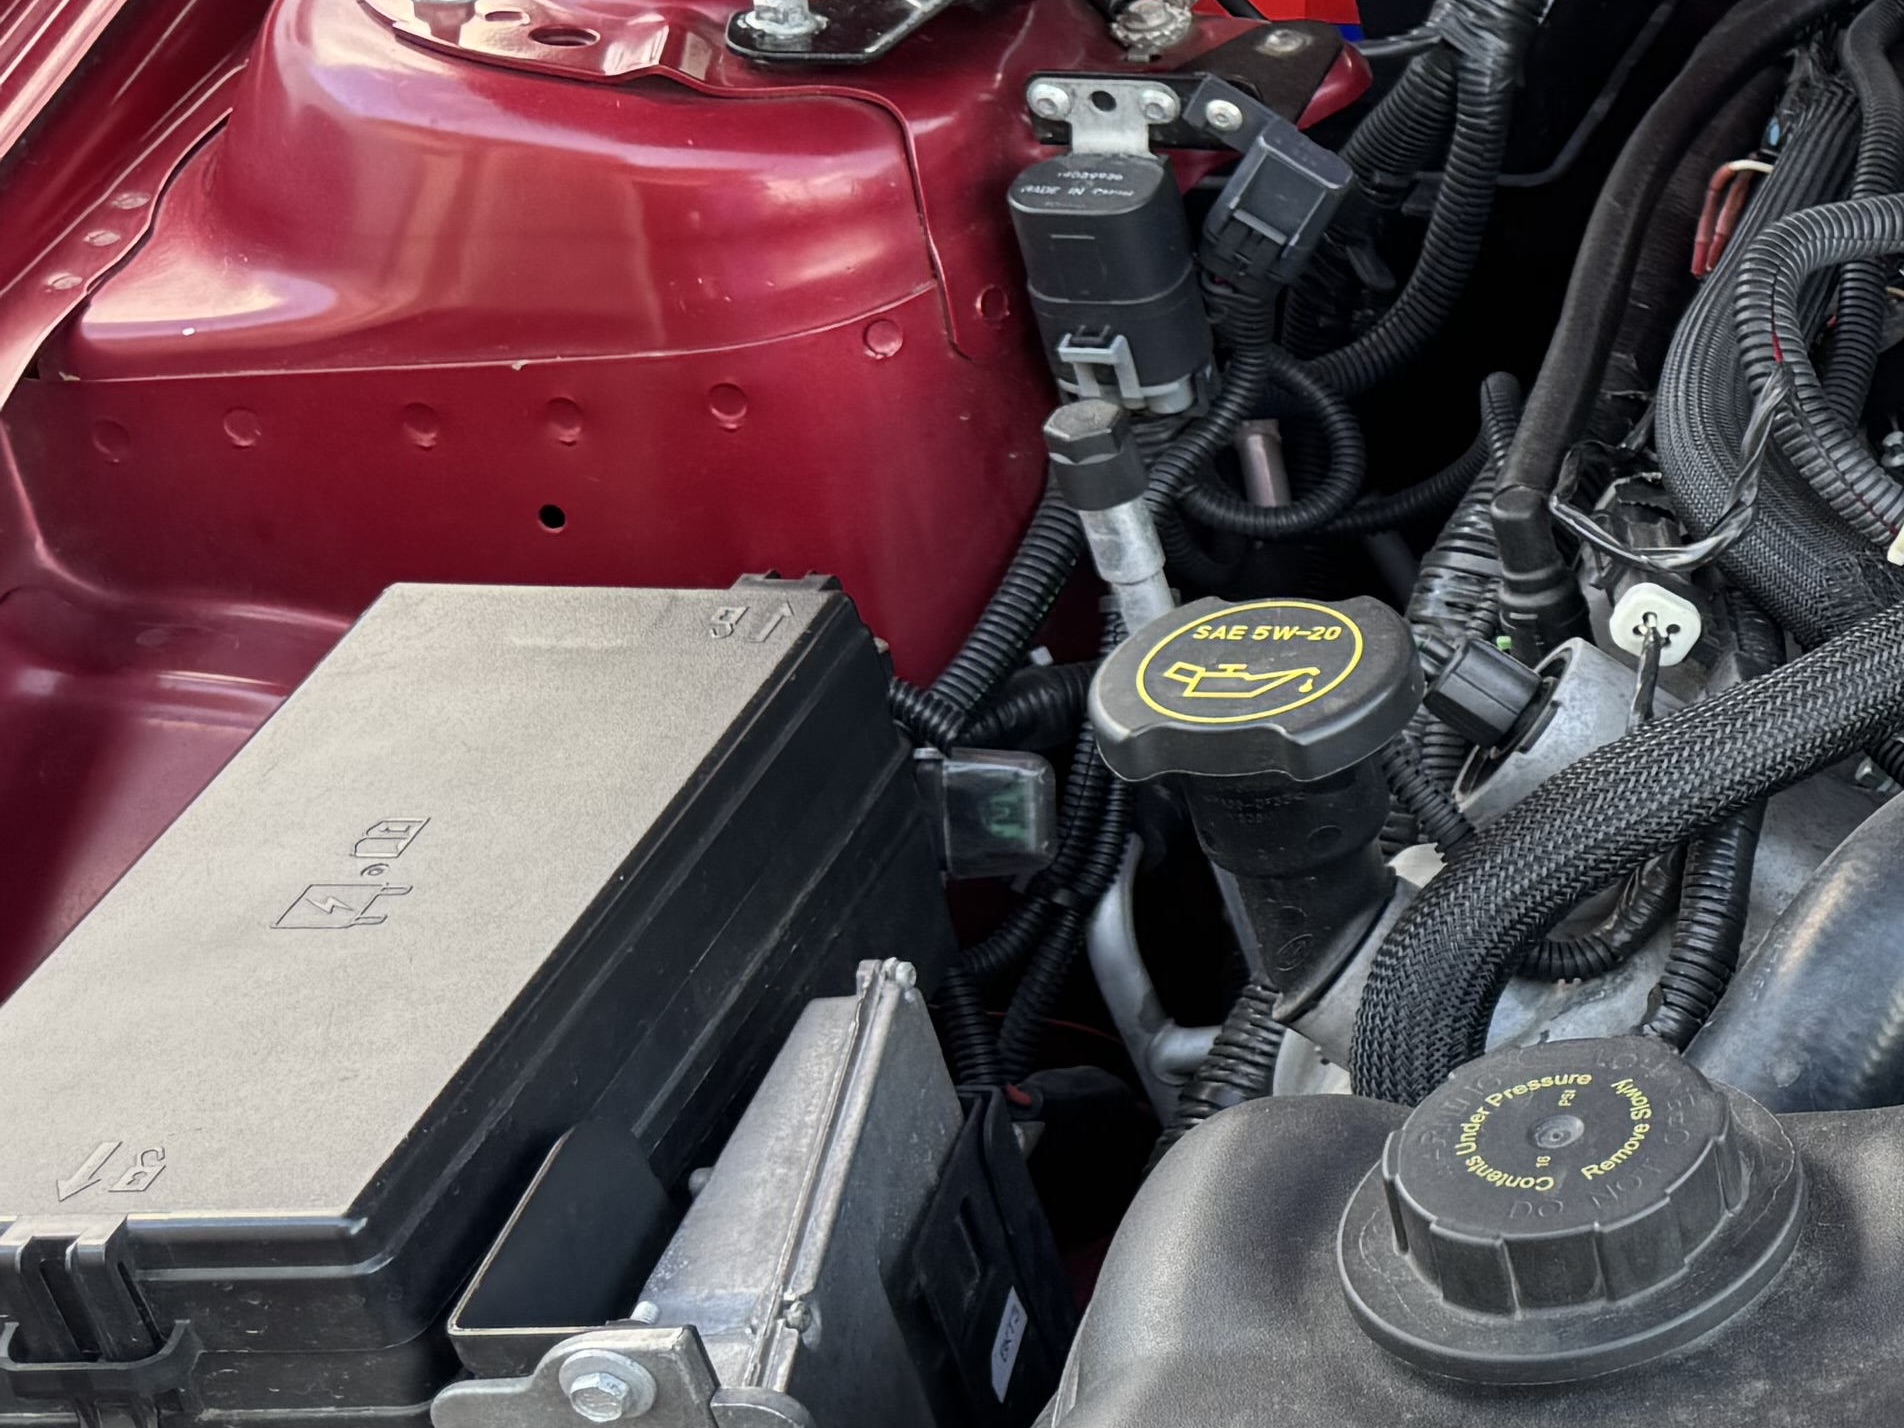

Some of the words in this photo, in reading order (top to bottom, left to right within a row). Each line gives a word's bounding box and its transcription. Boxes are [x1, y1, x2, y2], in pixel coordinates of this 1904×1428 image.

[1192, 624, 1248, 641] SAE
[1251, 624, 1343, 642] 5W-20
[1484, 1072, 1593, 1108] Pressure
[1558, 1088, 1577, 1108] PSI
[1610, 1077, 1652, 1122] Slowly
[1455, 1106, 1491, 1157] Under
[1580, 1122, 1651, 1181] Remove
[1465, 1154, 1555, 1192] Contents
